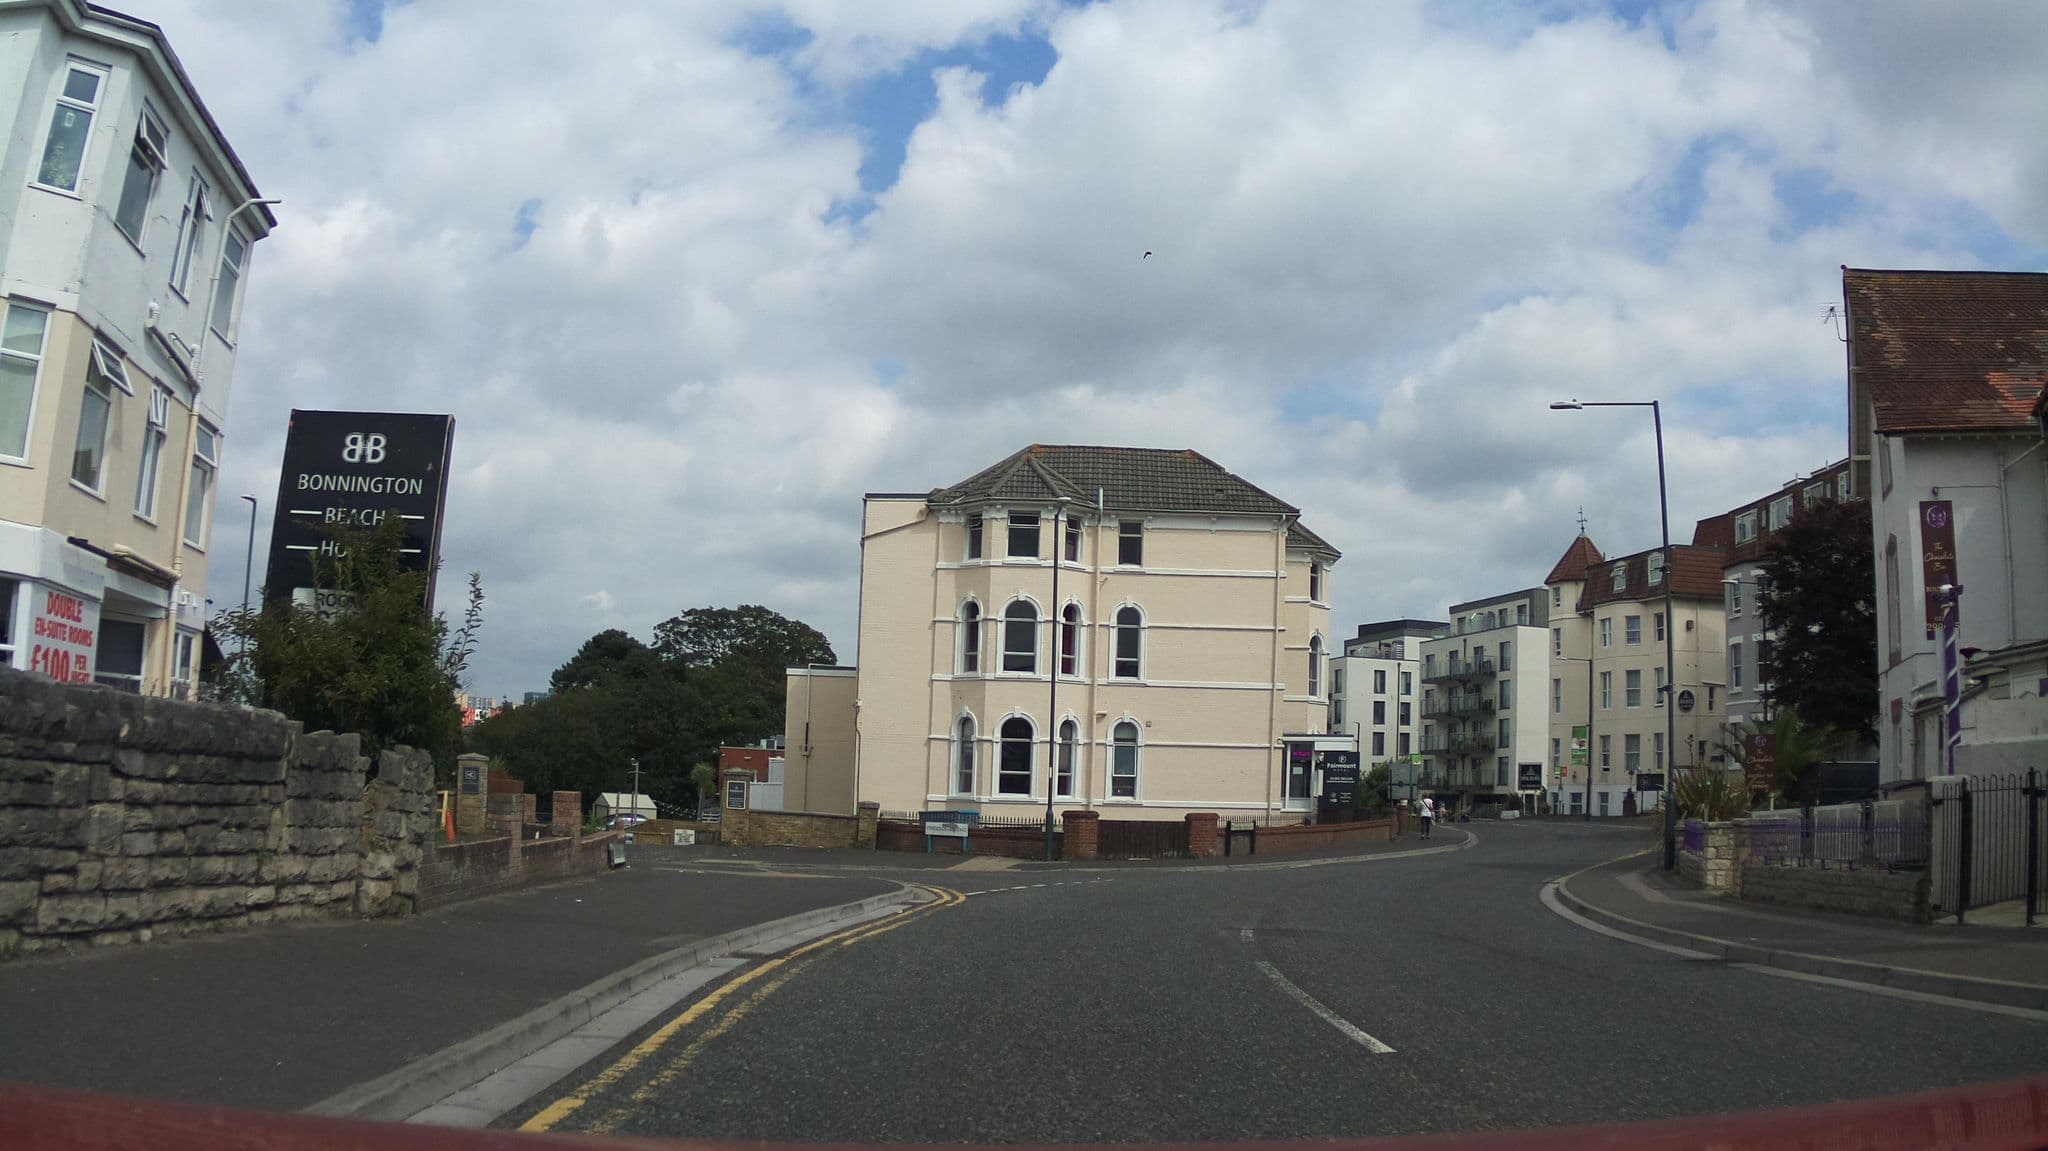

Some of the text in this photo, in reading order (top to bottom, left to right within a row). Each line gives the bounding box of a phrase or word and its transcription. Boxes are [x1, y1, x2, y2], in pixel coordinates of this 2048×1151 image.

[297, 473, 423, 494] BONNINGTON
[324, 507, 386, 526] BEACH
[47, 591, 83, 623] DOUBLE
[34, 616, 93, 647] EN-SUITE ROOMS
[30, 644, 70, 683] £100
